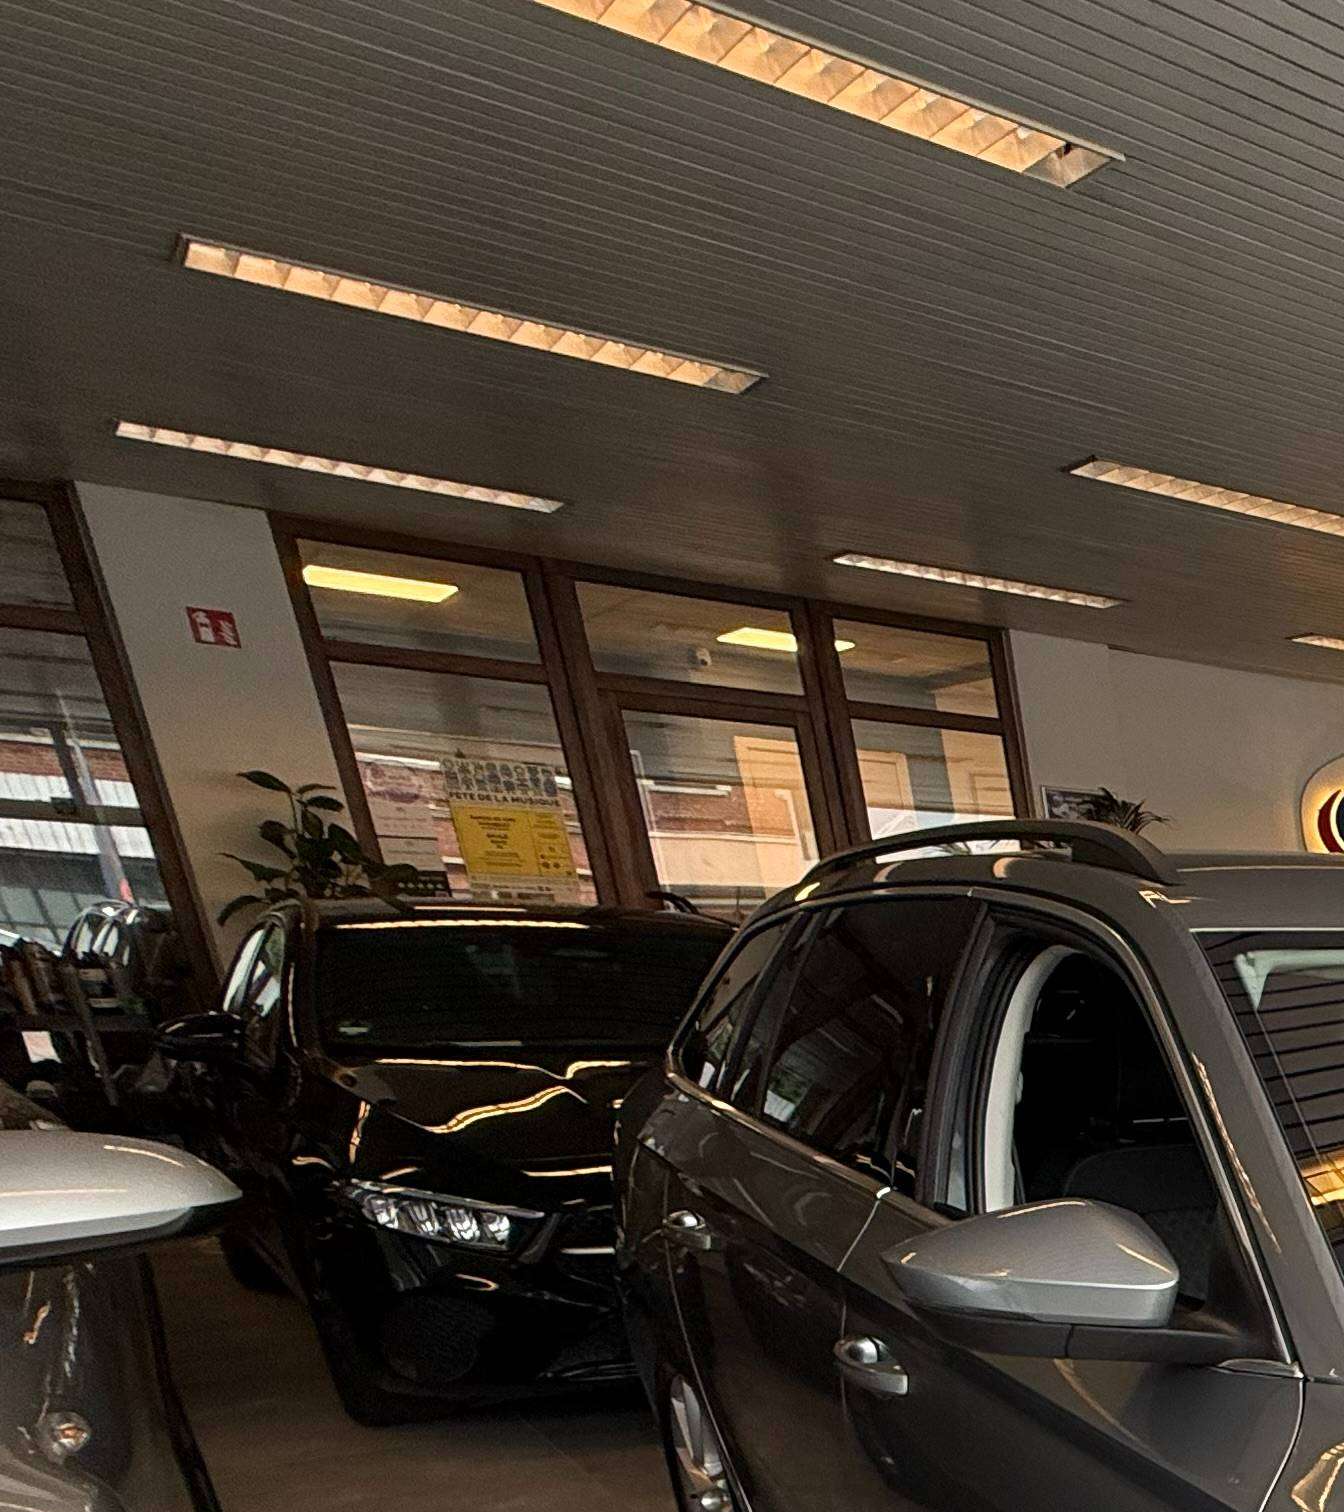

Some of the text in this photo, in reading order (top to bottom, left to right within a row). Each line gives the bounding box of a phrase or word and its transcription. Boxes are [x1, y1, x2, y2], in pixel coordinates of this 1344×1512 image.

[477, 793, 493, 801] DE
[494, 794, 509, 803] LA
[511, 796, 561, 807] MUSIQUE
